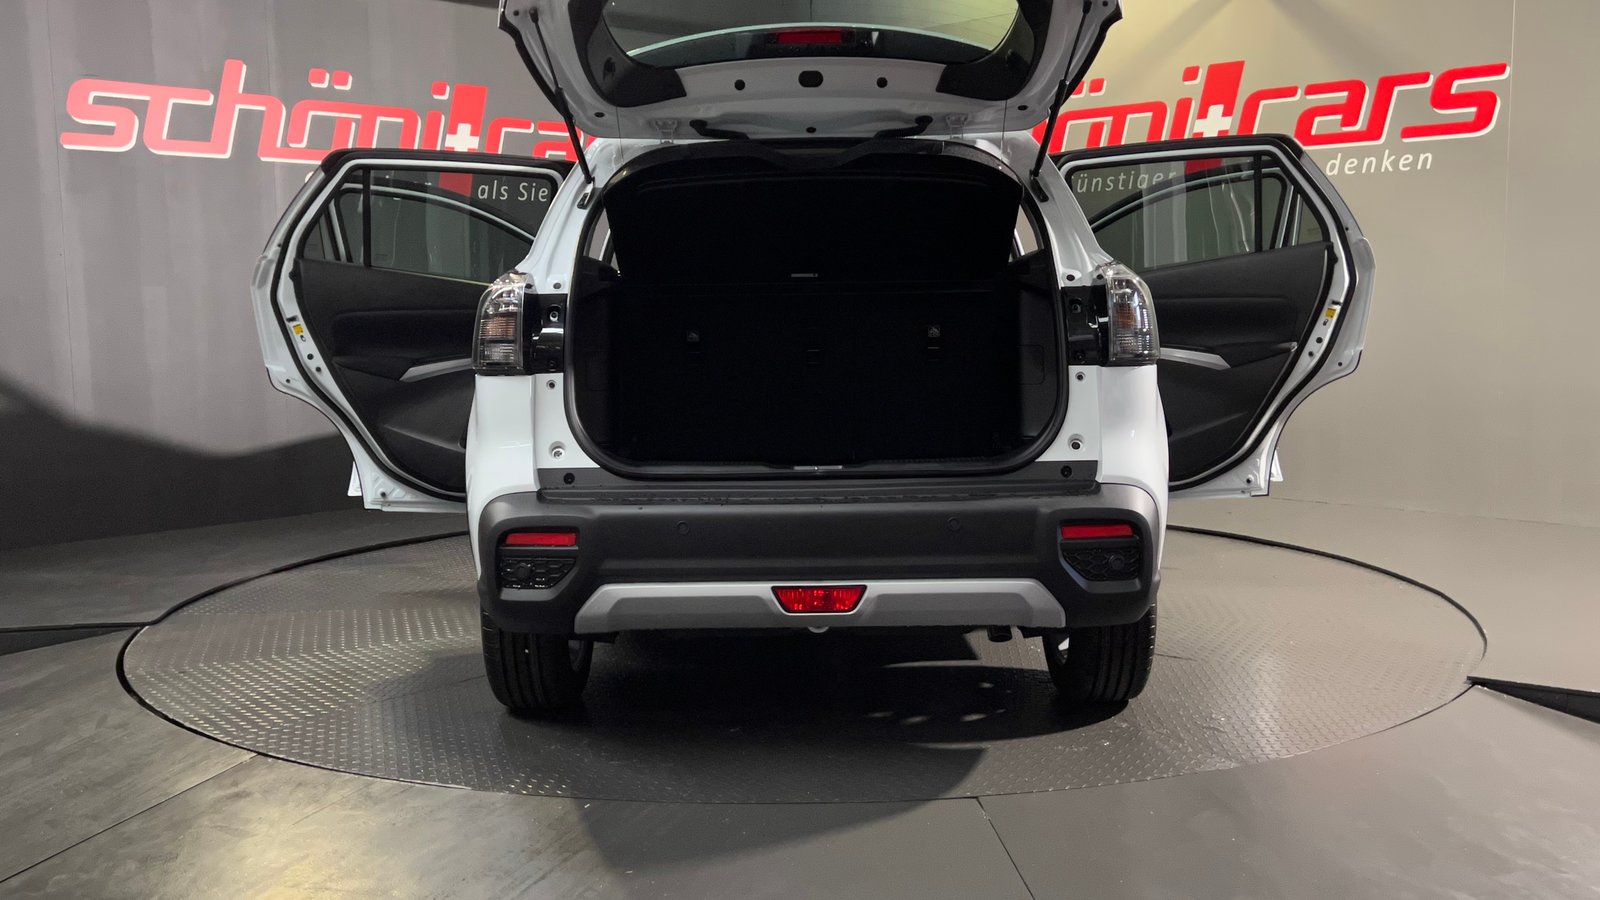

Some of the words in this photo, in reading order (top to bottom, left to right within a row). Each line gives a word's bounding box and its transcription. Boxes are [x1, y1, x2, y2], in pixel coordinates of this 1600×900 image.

[1072, 171, 1177, 193] ünstiger
[1325, 149, 1434, 177] denken
[477, 180, 508, 201] als
[517, 182, 549, 203] Sie
